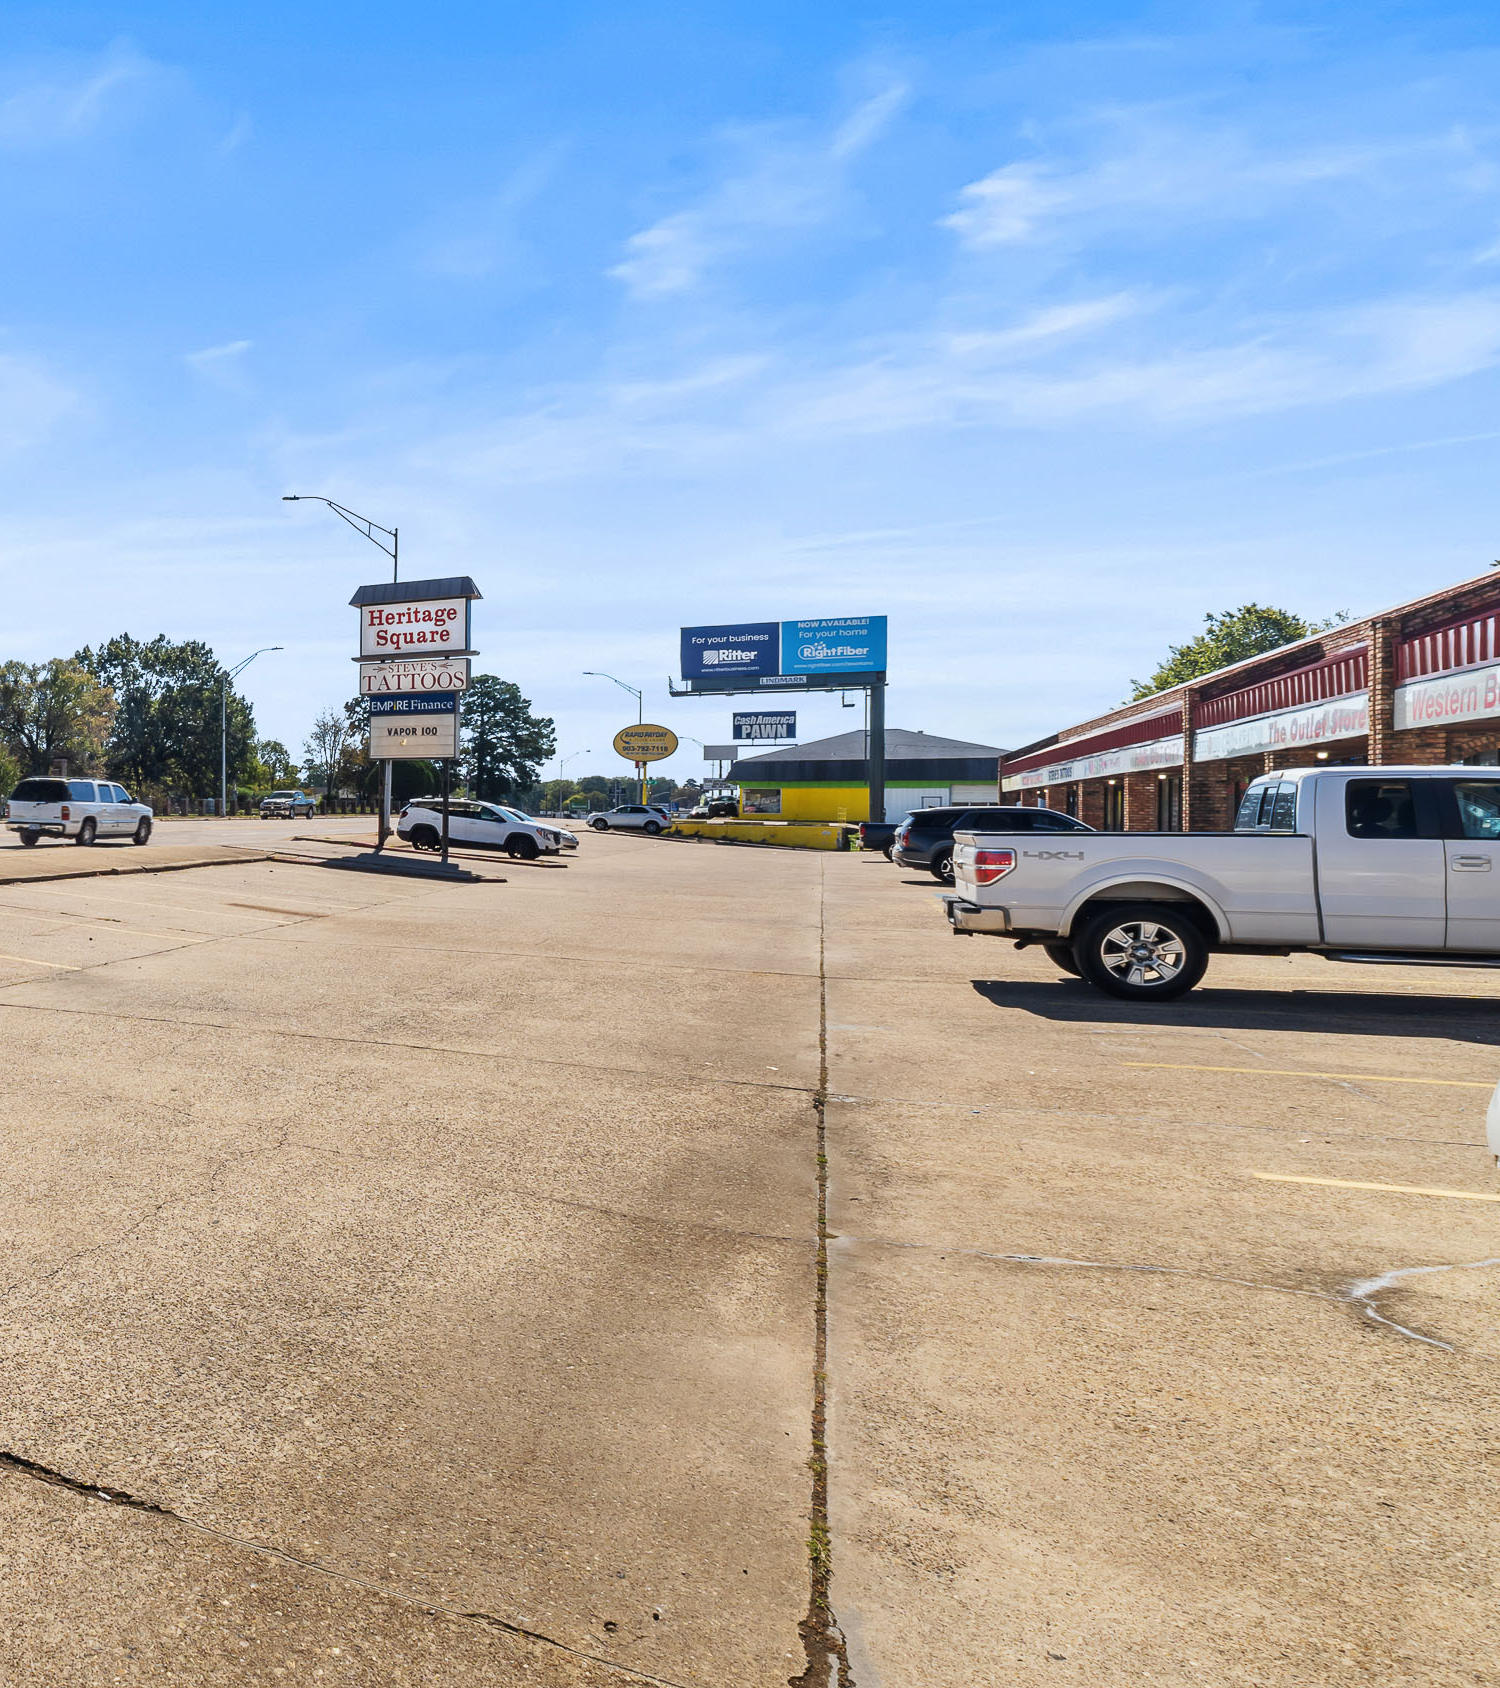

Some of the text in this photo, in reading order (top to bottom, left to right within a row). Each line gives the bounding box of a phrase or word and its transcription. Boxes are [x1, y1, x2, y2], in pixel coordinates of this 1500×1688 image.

[368, 607, 457, 627] Heritage
[821, 618, 870, 627] AVAILABLE!
[376, 629, 450, 650] Square
[707, 636, 727, 645] your
[729, 634, 769, 642] business
[815, 630, 837, 639] your
[719, 649, 758, 661] Ritter
[803, 646, 869, 659] RightFiber
[388, 662, 437, 673] STEVE'S
[363, 671, 465, 692] TATTOOS
[1412, 673, 1500, 720] Western B
[371, 700, 453, 712] EMPIRE Finance
[734, 715, 795, 725] Cash America
[387, 728, 418, 736] VAPOR
[741, 724, 787, 738] PAWN
[1268, 720, 1286, 744] The
[1290, 712, 1327, 742] Outlet
[1331, 709, 1365, 735] Store
